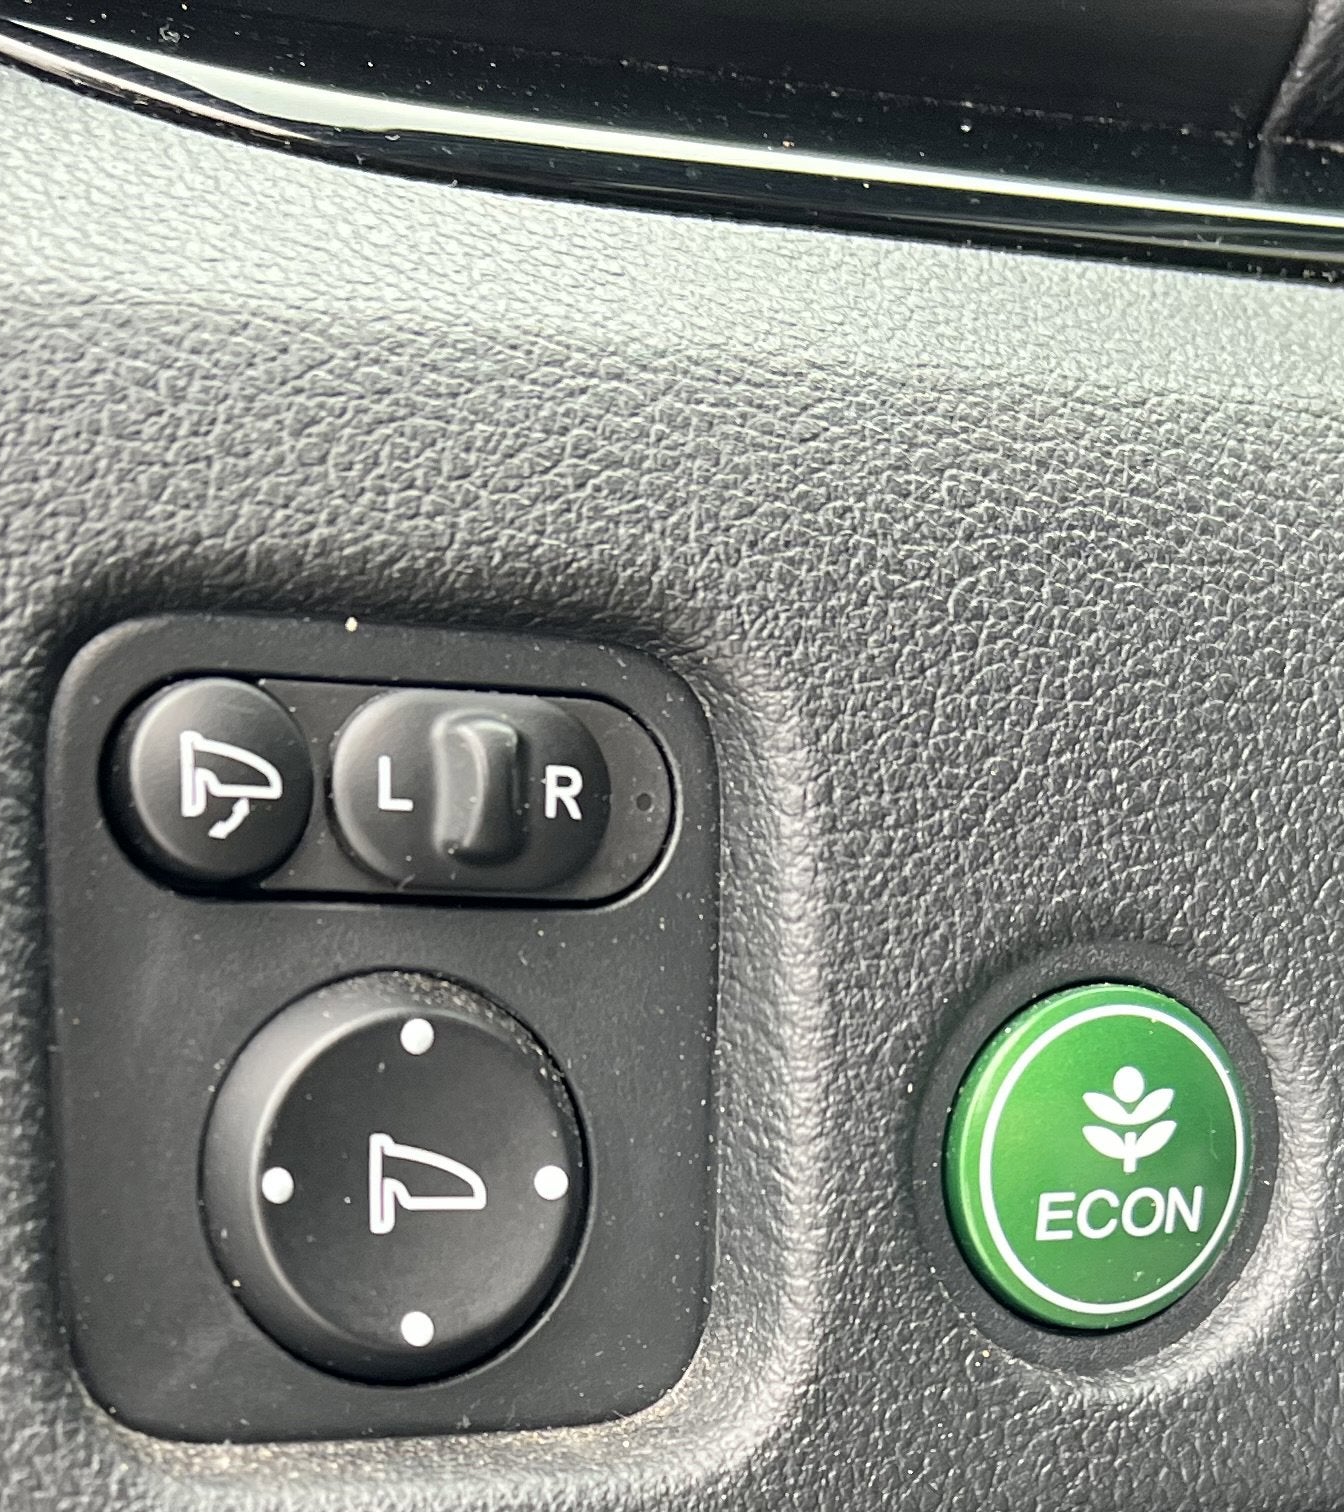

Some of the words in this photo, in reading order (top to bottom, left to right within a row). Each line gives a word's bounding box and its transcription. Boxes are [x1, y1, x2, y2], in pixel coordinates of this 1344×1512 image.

[377, 755, 413, 811] L
[544, 765, 583, 821] R
[1035, 1185, 1204, 1242] ECON
